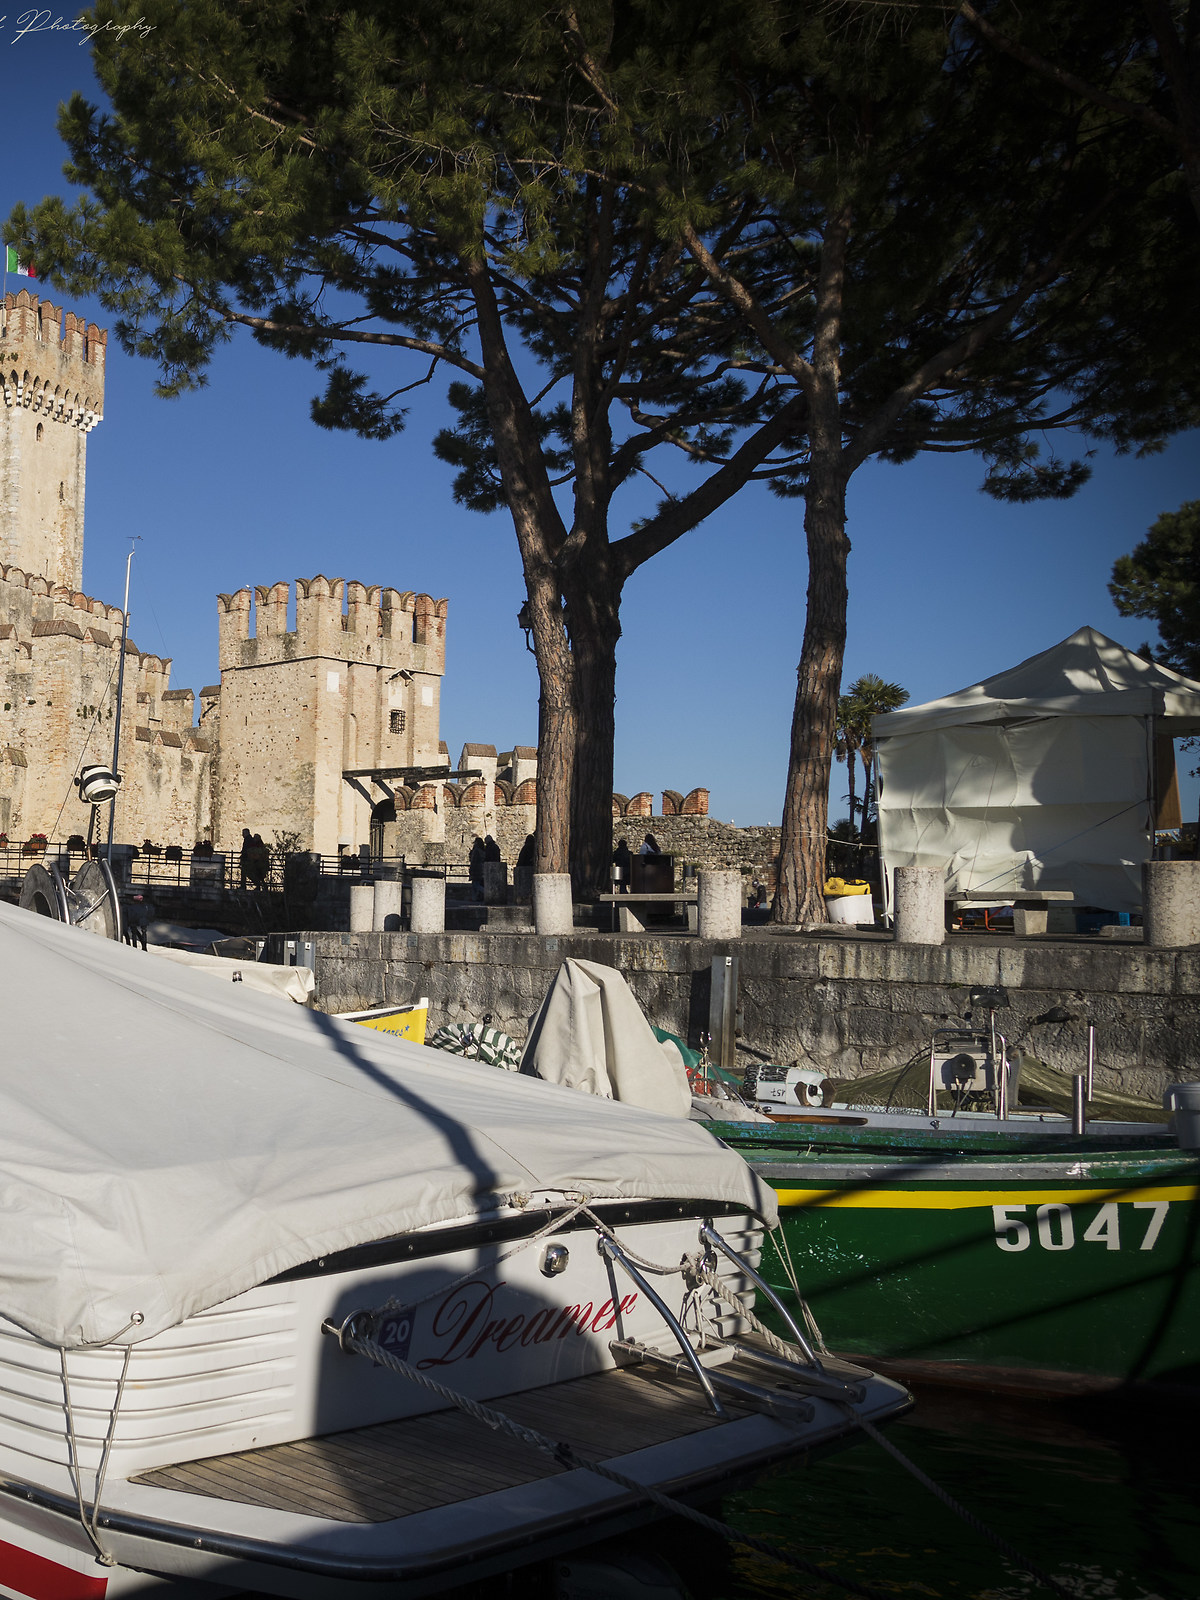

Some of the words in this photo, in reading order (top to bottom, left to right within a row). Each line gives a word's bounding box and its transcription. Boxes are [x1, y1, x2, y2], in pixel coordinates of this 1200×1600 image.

[991, 1200, 1170, 1252] 5047
[383, 1319, 411, 1345] 20
[415, 1280, 639, 1371] Dreamer
